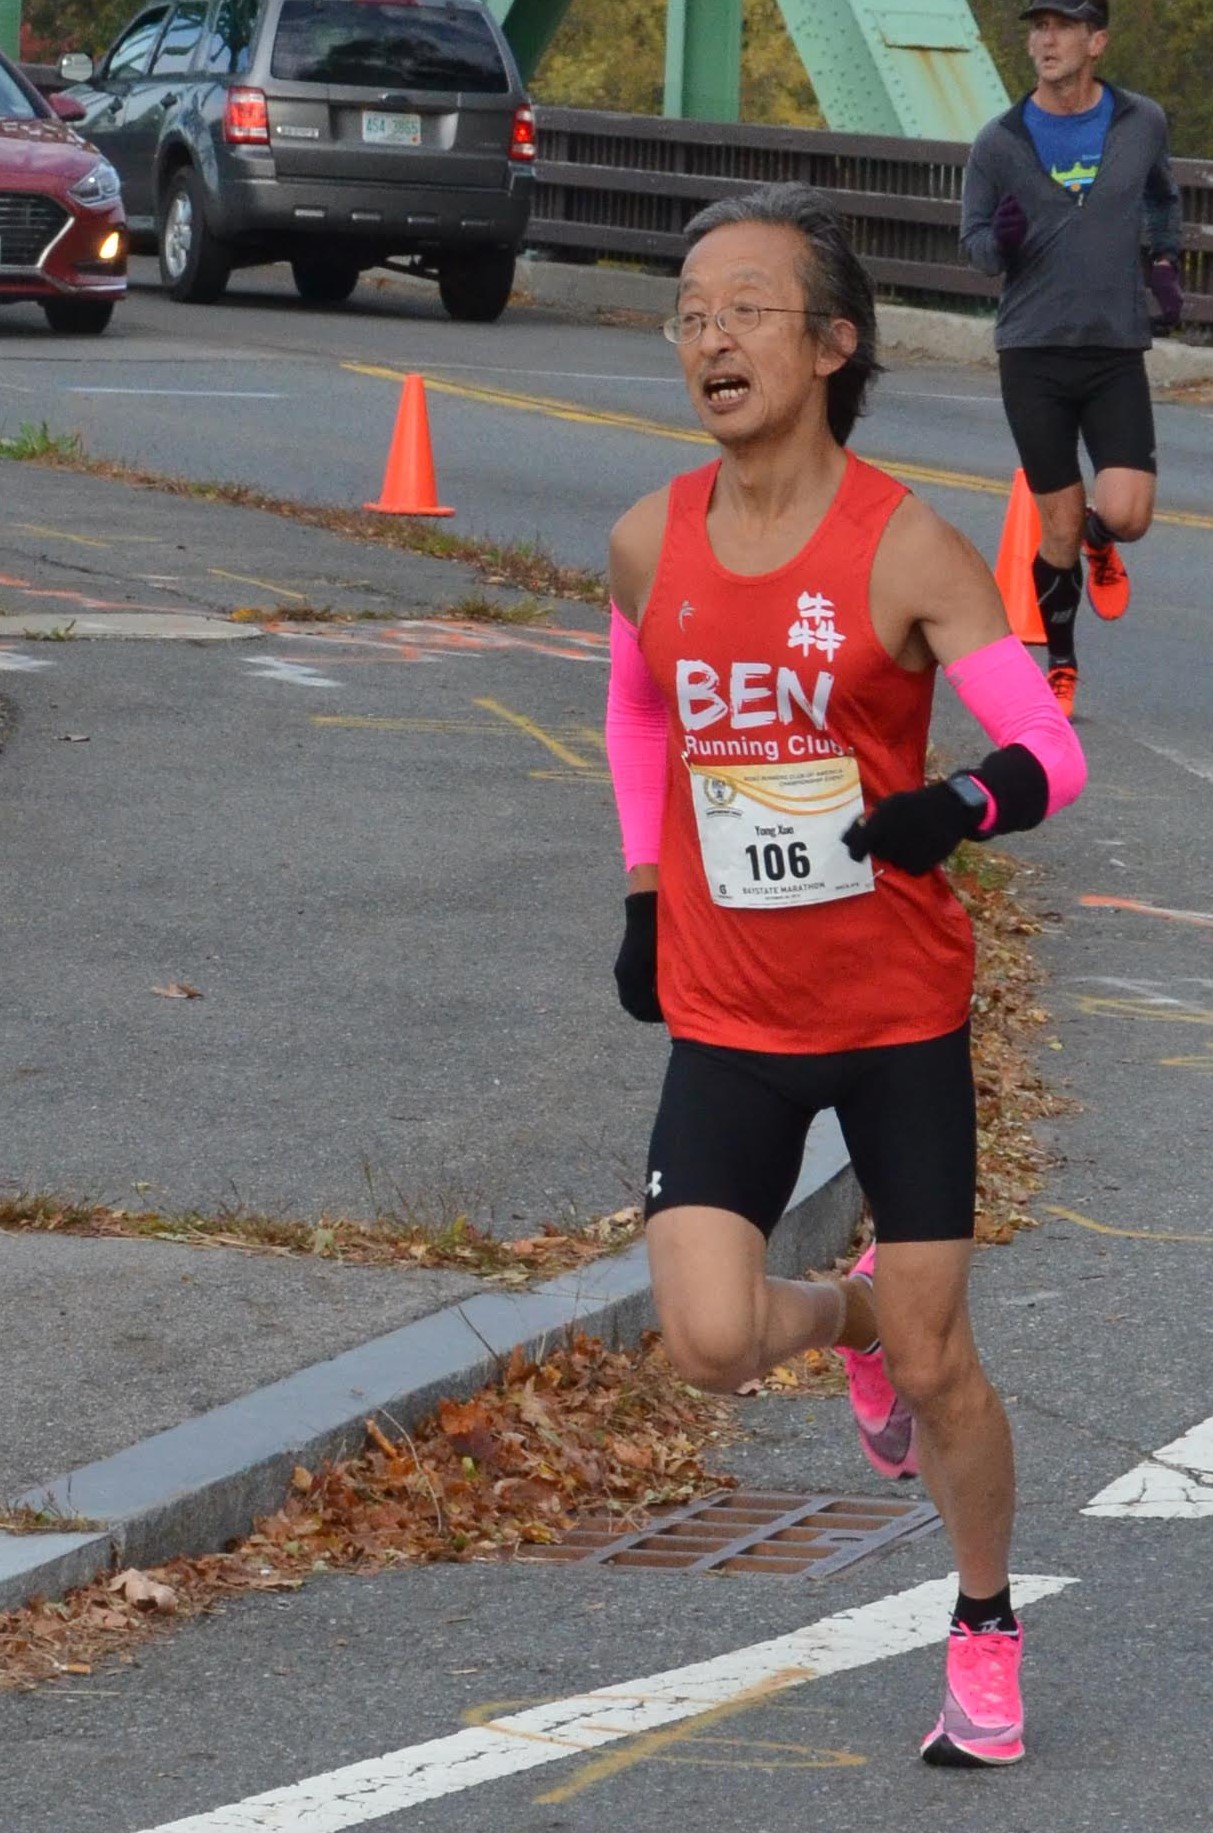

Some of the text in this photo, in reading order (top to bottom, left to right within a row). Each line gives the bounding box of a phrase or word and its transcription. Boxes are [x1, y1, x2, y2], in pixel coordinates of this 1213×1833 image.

[787, 591, 846, 663] 犇
[676, 659, 833, 731] BEN
[685, 735, 779, 761] Running
[754, 825, 776, 838] Yong
[745, 842, 811, 882] 106
[743, 886, 779, 895] BAYSTATE
[780, 882, 826, 893] MARATHON
